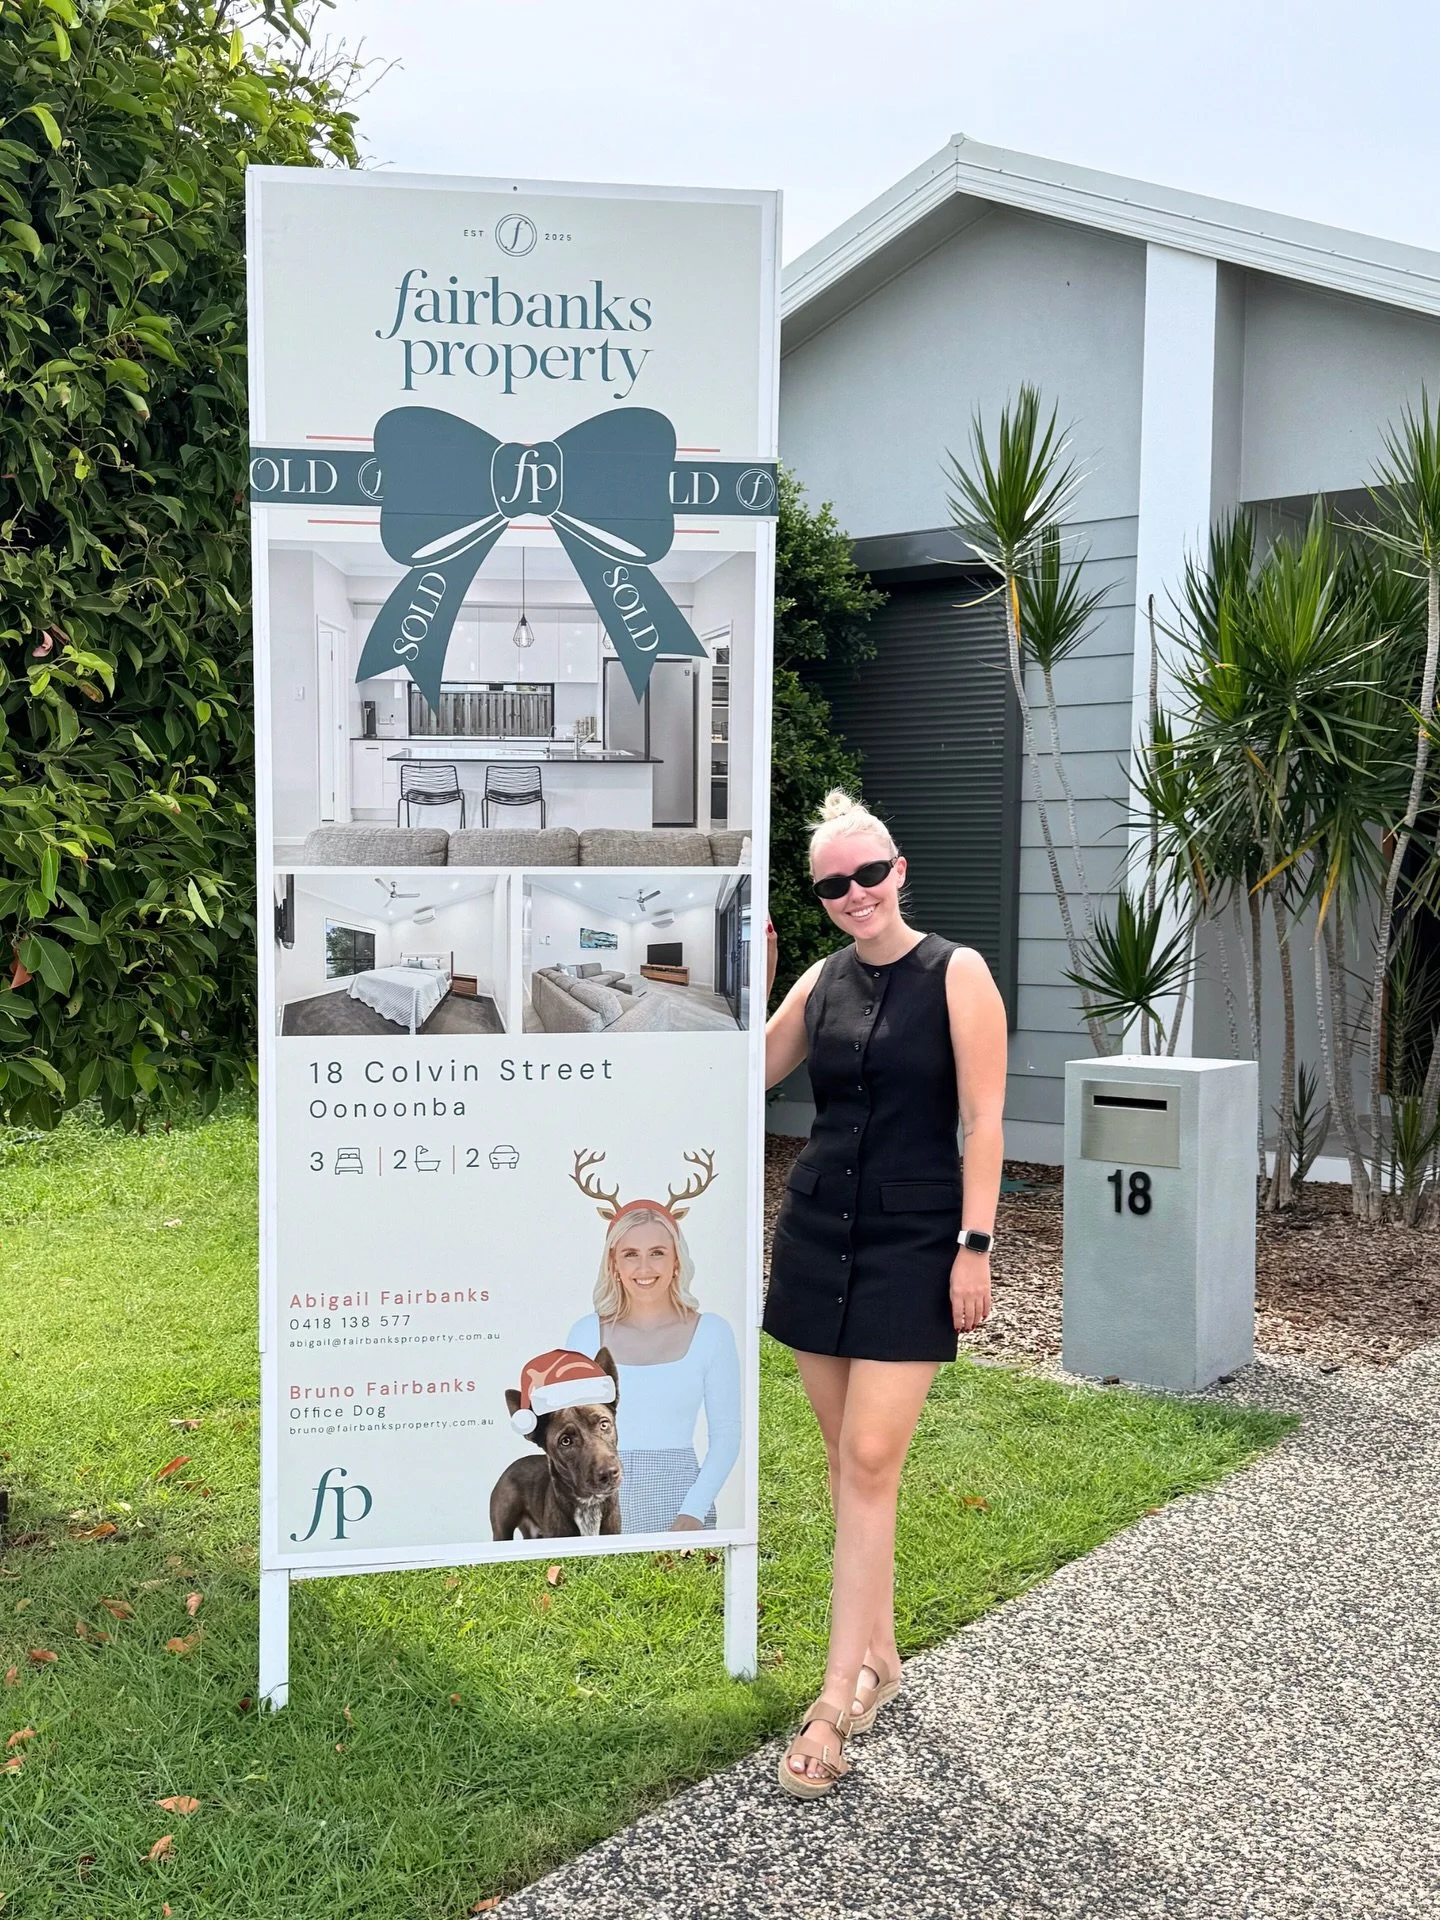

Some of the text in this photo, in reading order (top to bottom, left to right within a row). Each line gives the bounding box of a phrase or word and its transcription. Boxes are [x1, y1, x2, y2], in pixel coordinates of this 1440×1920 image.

[463, 229, 485, 238] EST
[544, 232, 572, 242] 2025
[375, 268, 653, 339] fairbanks
[400, 337, 654, 400] property
[249, 456, 338, 494] OLD
[500, 448, 557, 504] fp
[668, 471, 720, 505] LD
[392, 571, 447, 662] SOLD
[603, 565, 660, 652] SOLD
[309, 1058, 613, 1084] 18 Colvin Street
[309, 1097, 466, 1119] Oonoonba
[309, 1147, 480, 1172] 3 2 2
[1107, 1168, 1153, 1216] 18
[289, 1287, 490, 1311] Abigail Fairbanks
[289, 1314, 411, 1331] 0418 138 577
[289, 1332, 500, 1349] abigail@fairbanksproperty.com.au
[290, 1378, 476, 1400] Bruno Fairbanks
[289, 1404, 386, 1420] Office Dog
[289, 1418, 494, 1436] bruno@fairbanksproperty.com.au
[289, 1466, 373, 1543] fp
